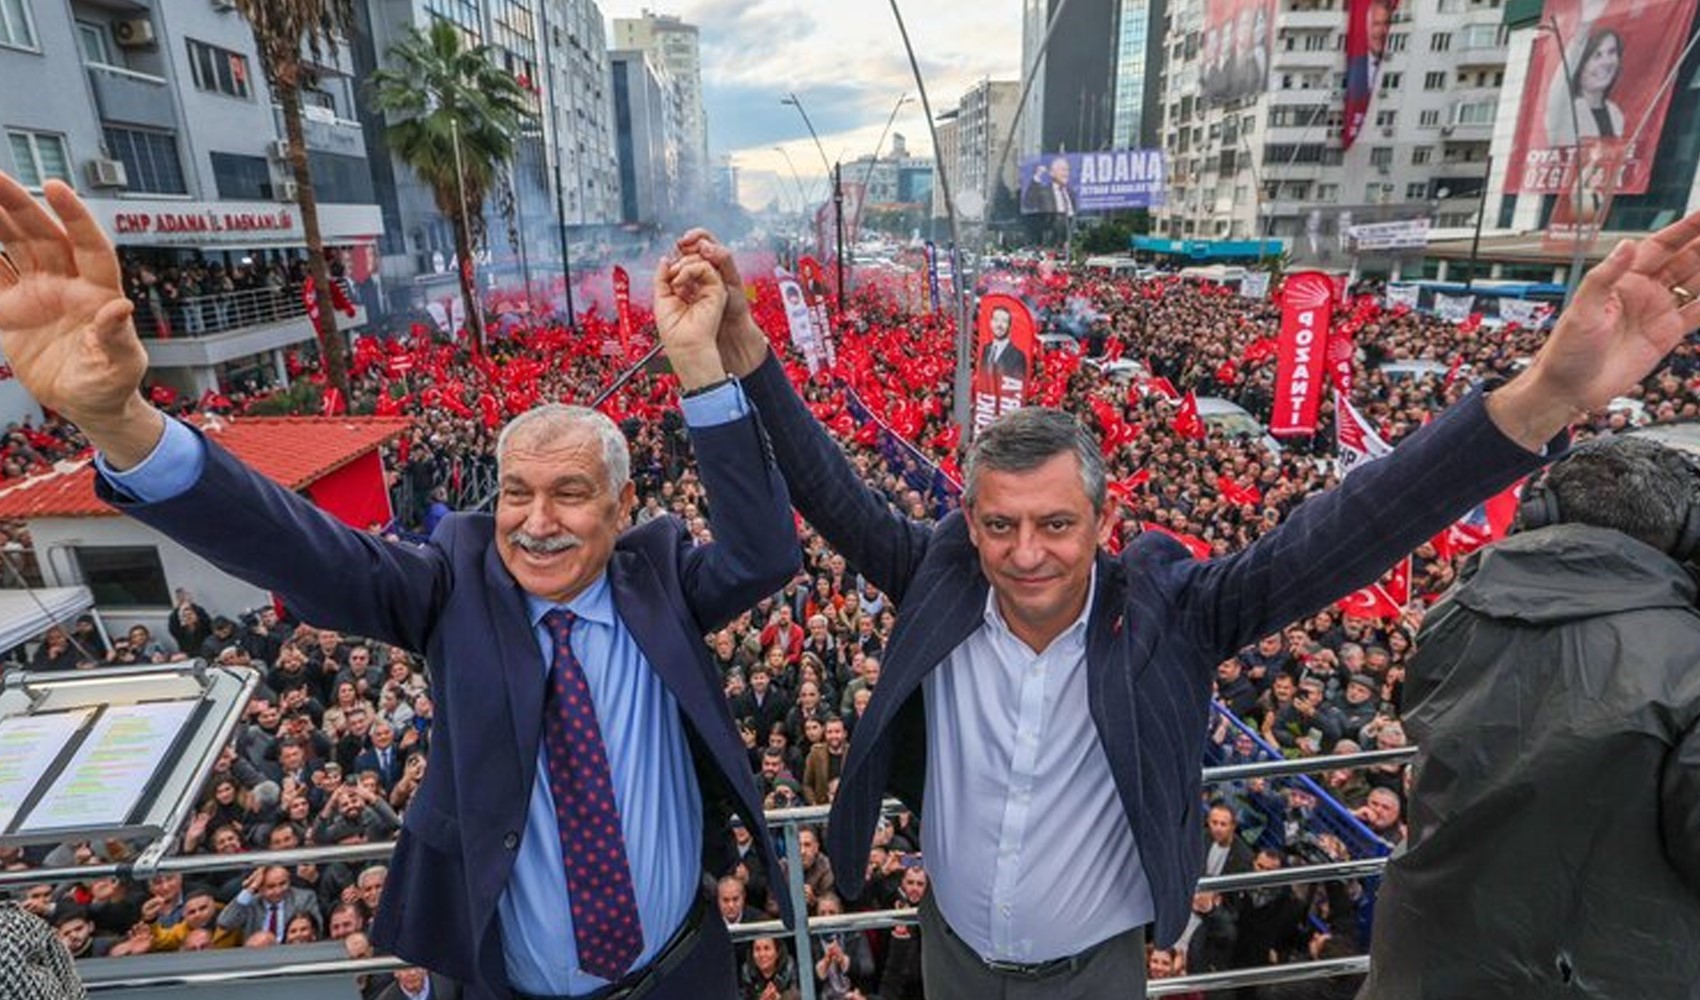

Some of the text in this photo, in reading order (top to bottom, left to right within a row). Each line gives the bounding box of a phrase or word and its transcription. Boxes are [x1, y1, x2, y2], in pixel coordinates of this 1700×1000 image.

[1080, 151, 1162, 184] ADANA
[114, 213, 151, 234] CHP
[155, 213, 208, 233] ADANA
